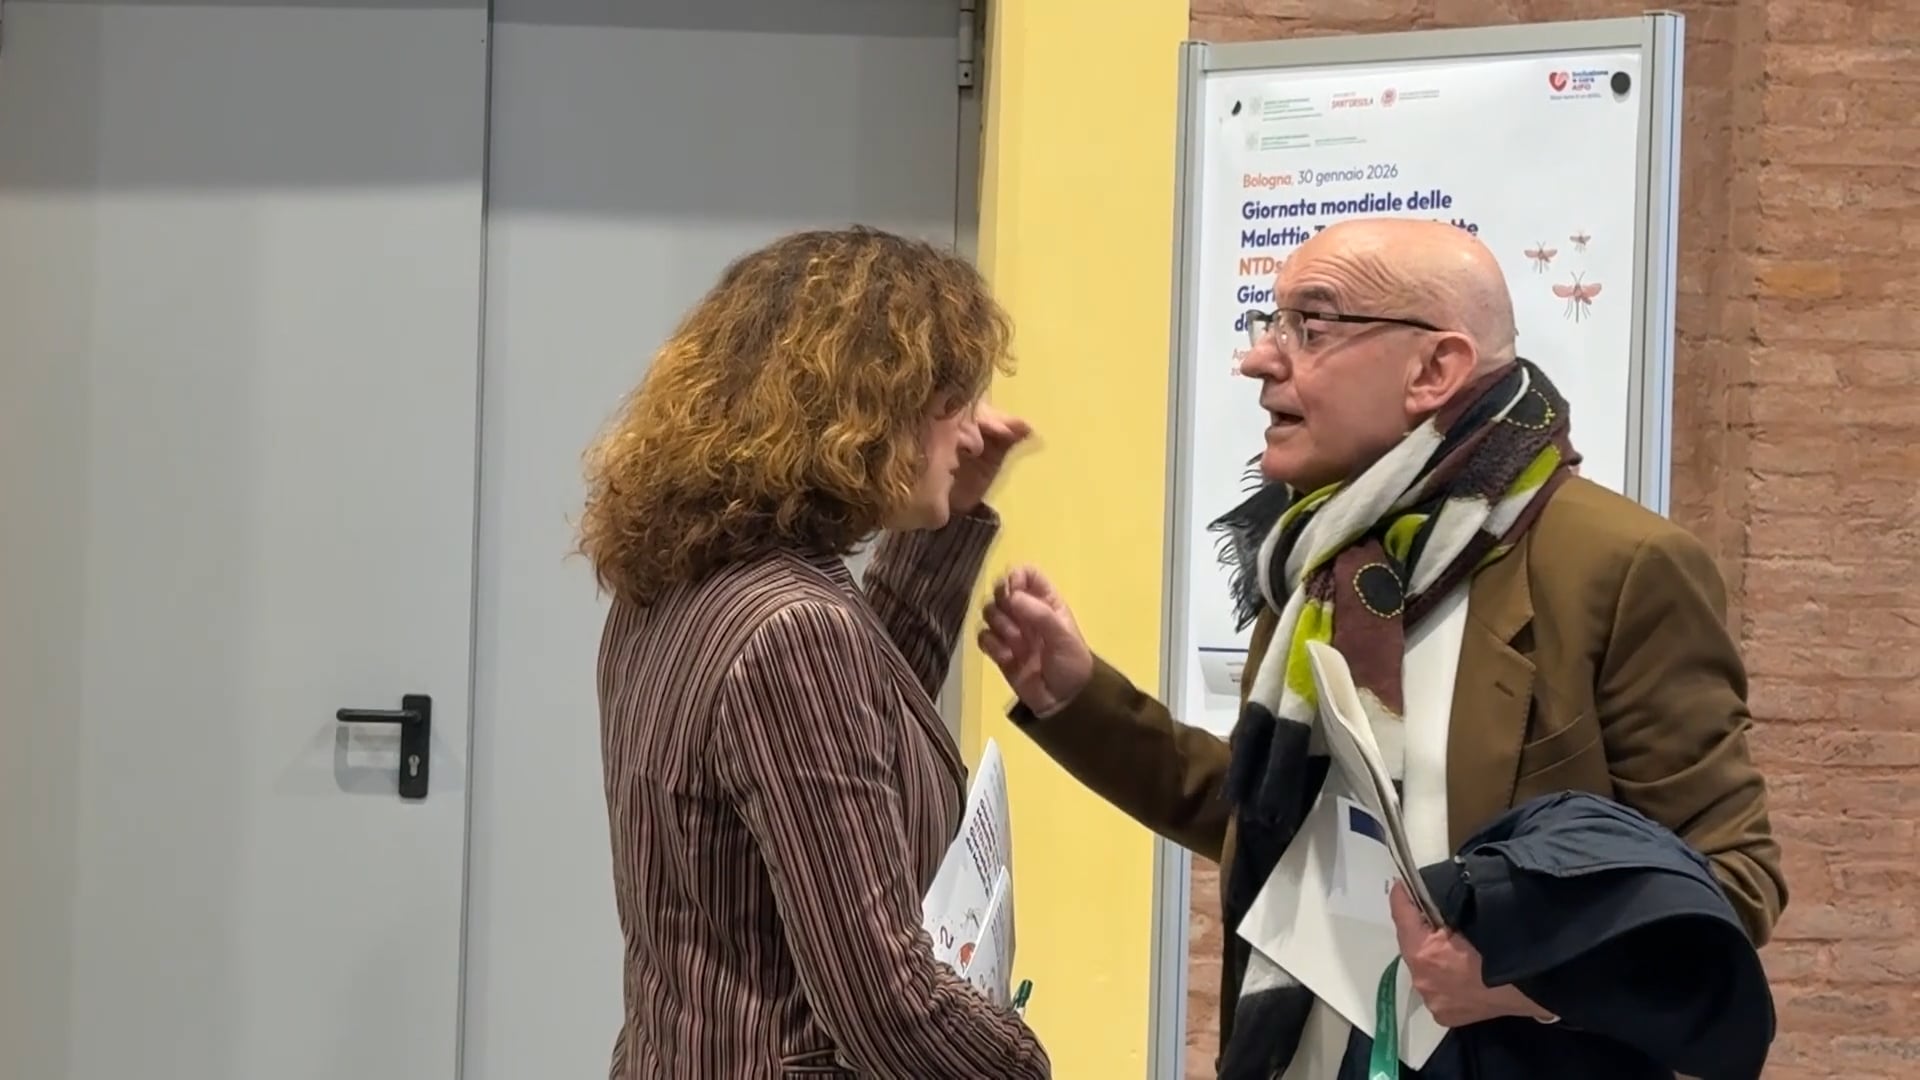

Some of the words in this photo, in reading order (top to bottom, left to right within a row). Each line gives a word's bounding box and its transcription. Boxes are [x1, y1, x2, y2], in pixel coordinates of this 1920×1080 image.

[1298, 169, 1314, 184] 30
[1316, 167, 1364, 187] gennaio
[1366, 163, 1398, 180] 2026
[1242, 198, 1316, 220] Giornata
[1320, 191, 1402, 214] mondiale
[1406, 189, 1452, 211] delle
[1241, 226, 1310, 248] Malattie
